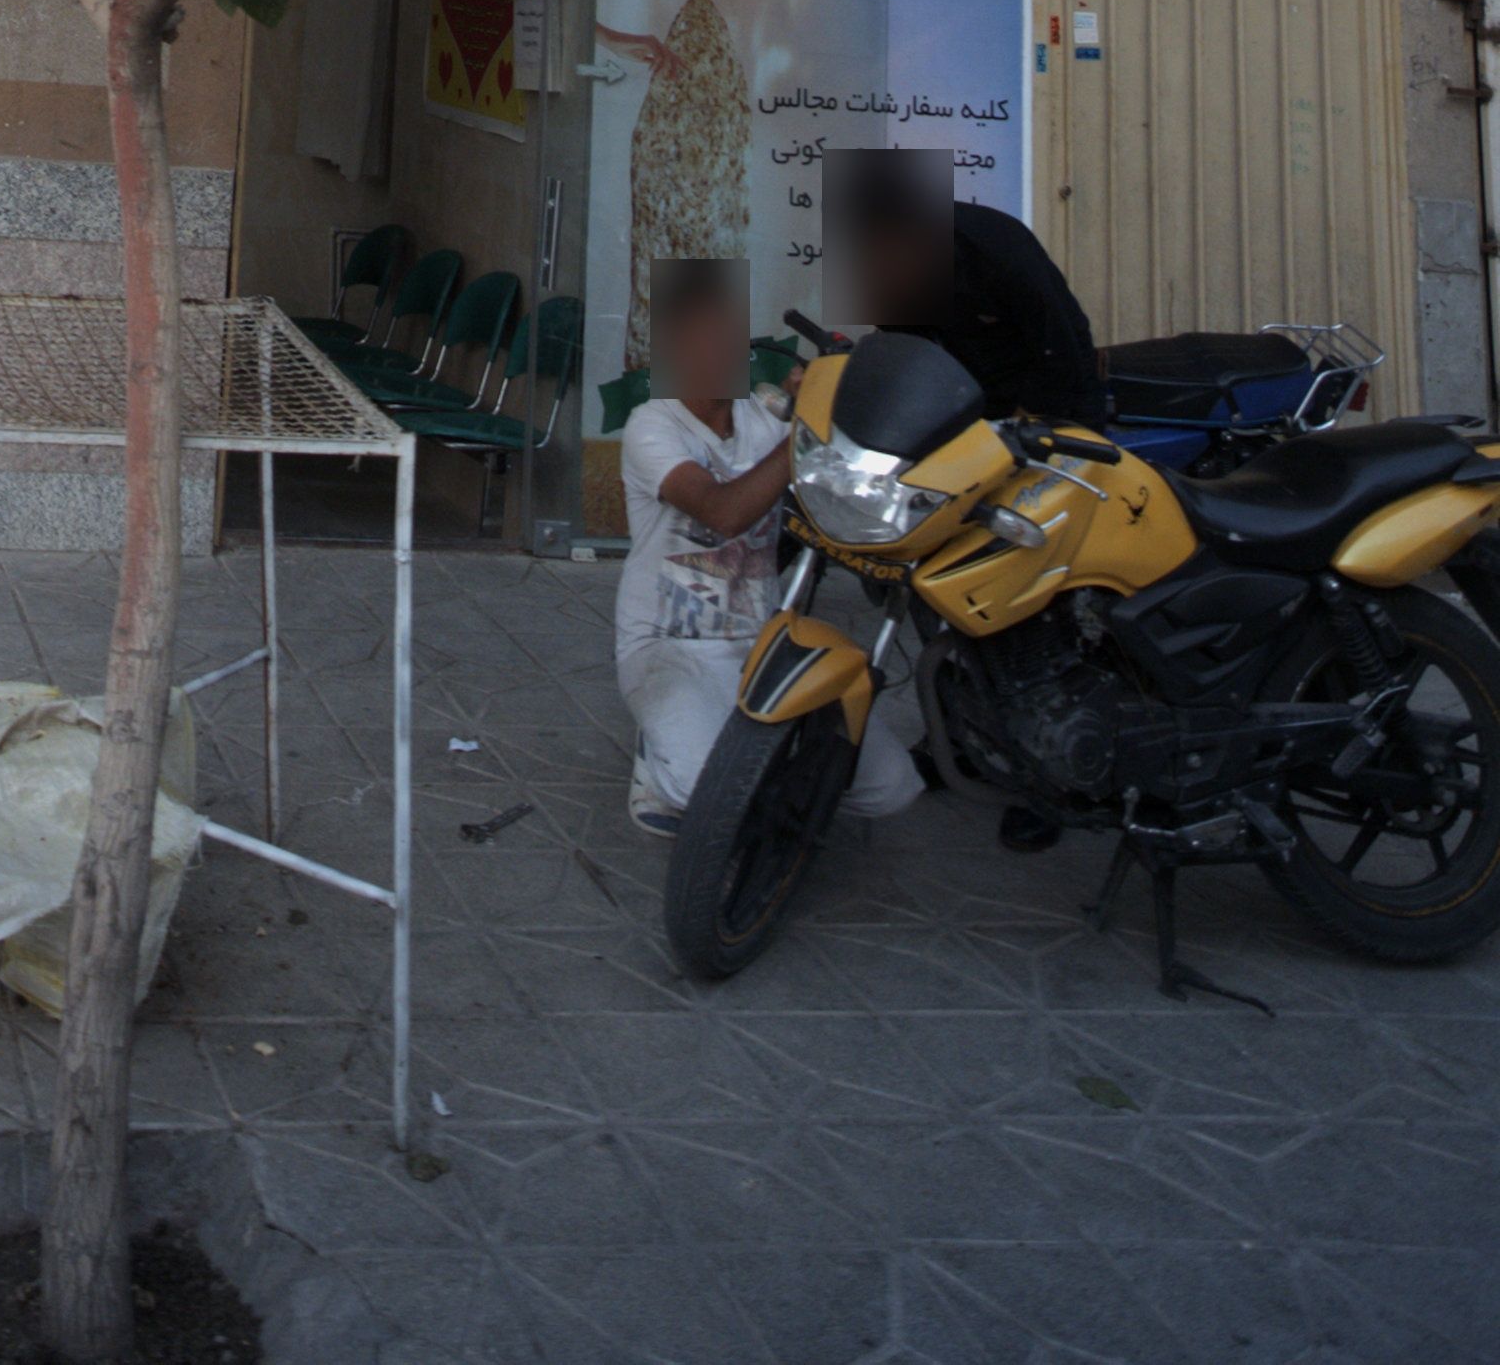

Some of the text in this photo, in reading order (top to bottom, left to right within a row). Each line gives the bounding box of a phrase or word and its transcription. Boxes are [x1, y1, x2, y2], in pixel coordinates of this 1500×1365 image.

[758, 88, 1010, 128] کلیه سفارشات مجالس
[786, 241, 823, 265] ود
